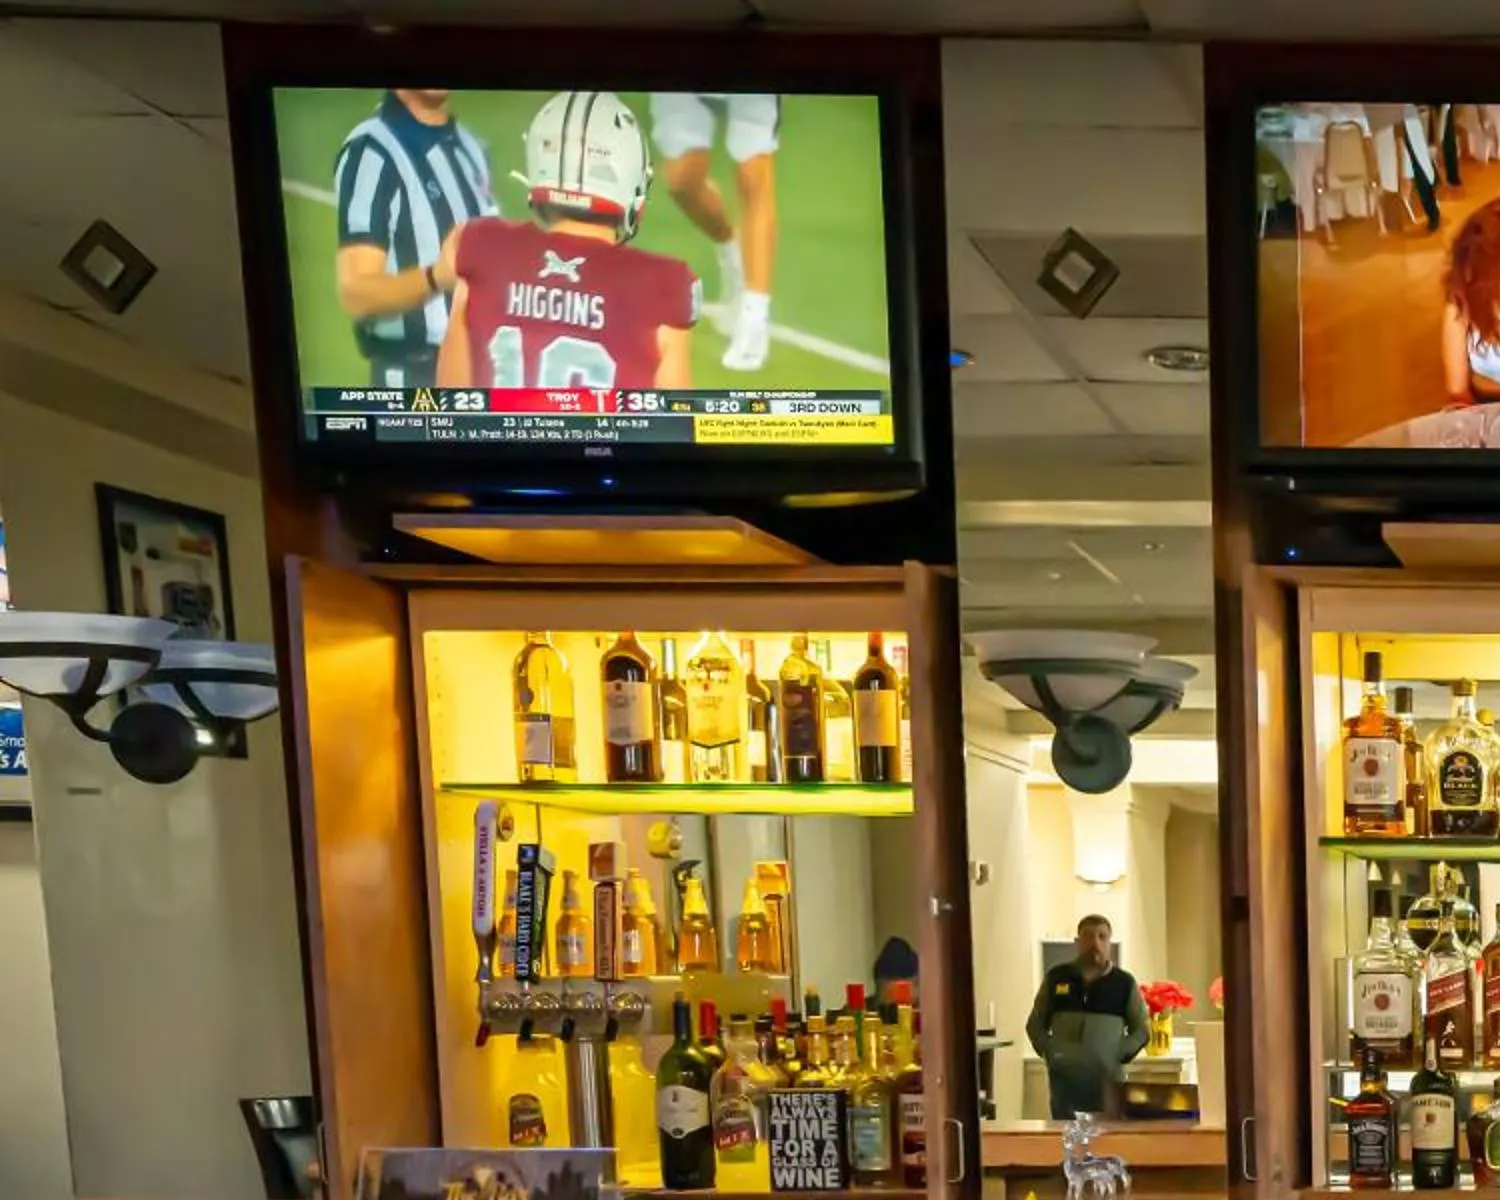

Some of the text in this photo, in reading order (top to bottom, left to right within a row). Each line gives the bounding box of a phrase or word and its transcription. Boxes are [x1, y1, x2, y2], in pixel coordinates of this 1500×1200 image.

[507, 282, 605, 330] HIGGINS
[340, 391, 405, 401] APP STATE
[453, 391, 485, 411] 23
[546, 391, 580, 402] TROY
[627, 392, 658, 411] 35
[789, 401, 862, 413] 3RD DOWN
[325, 417, 367, 431] ESPN
[431, 417, 453, 427] SMU
[477, 825, 490, 865] STELLA
[517, 914, 532, 943] HARD
[515, 945, 531, 977] CIDER
[771, 1093, 837, 1106] THERE'S
[771, 1106, 838, 1119] ALWAYS
[770, 1119, 839, 1140] TIME
[772, 1140, 838, 1158] FOR A
[772, 1157, 817, 1168] GLASS
[773, 1167, 841, 1189] WINE
